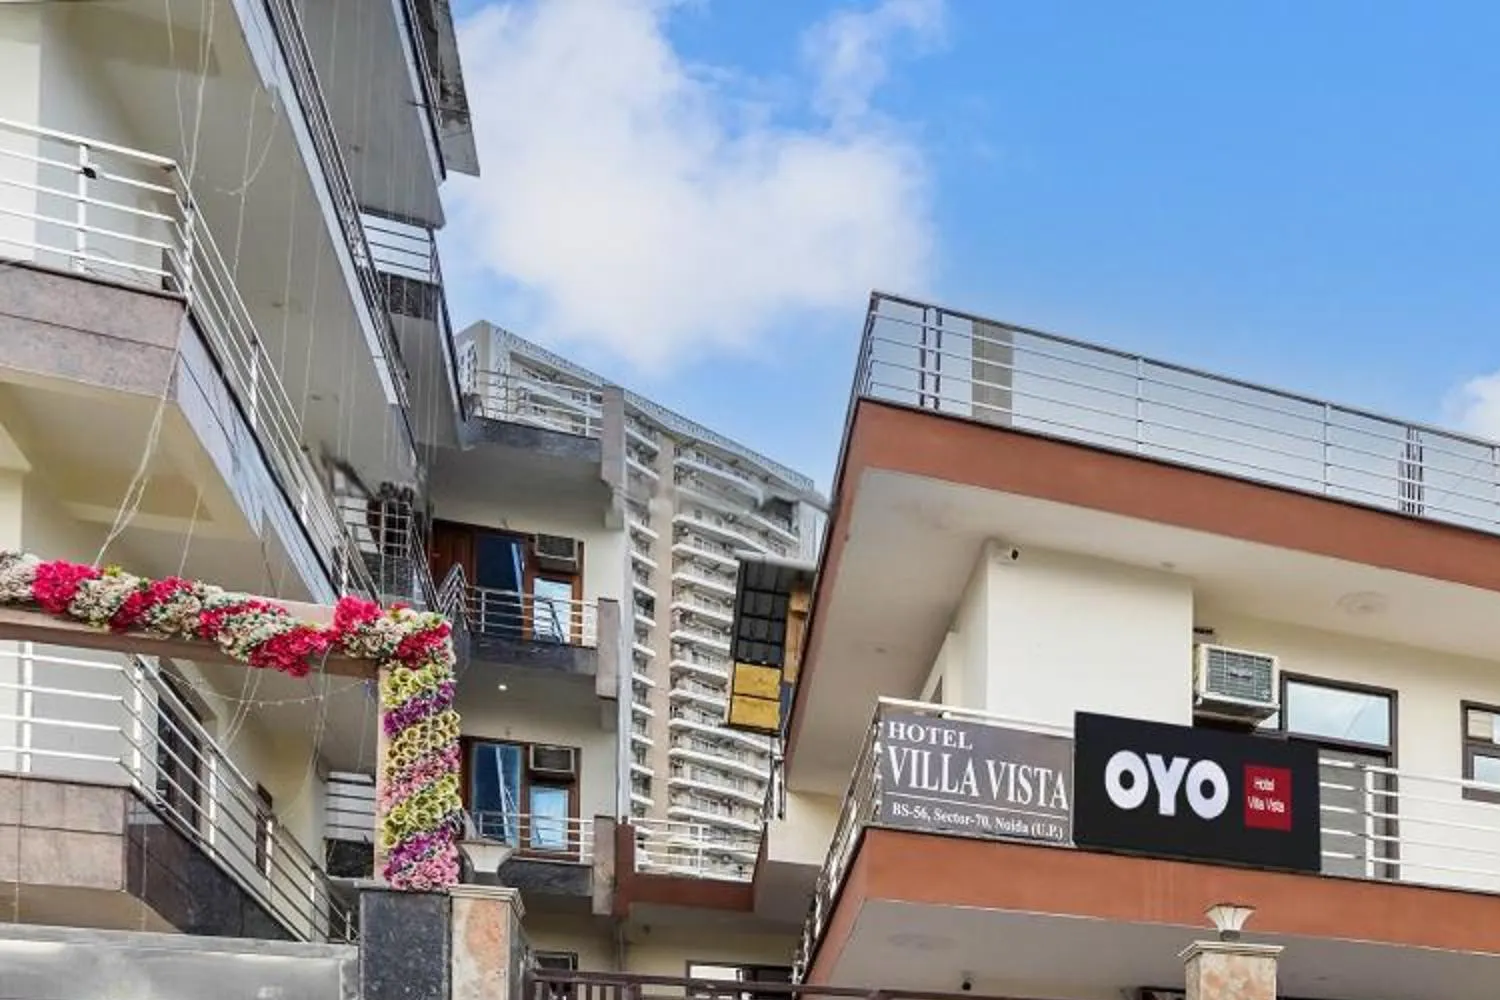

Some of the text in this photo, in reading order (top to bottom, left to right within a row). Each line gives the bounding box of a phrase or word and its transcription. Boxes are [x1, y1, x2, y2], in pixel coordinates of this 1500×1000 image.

[888, 721, 973, 750] HOTEL
[888, 745, 1069, 811] VILLA VISTA
[1105, 750, 1229, 819] OYO
[1253, 776, 1275, 791] Hotel
[994, 817, 1029, 834] Noida
